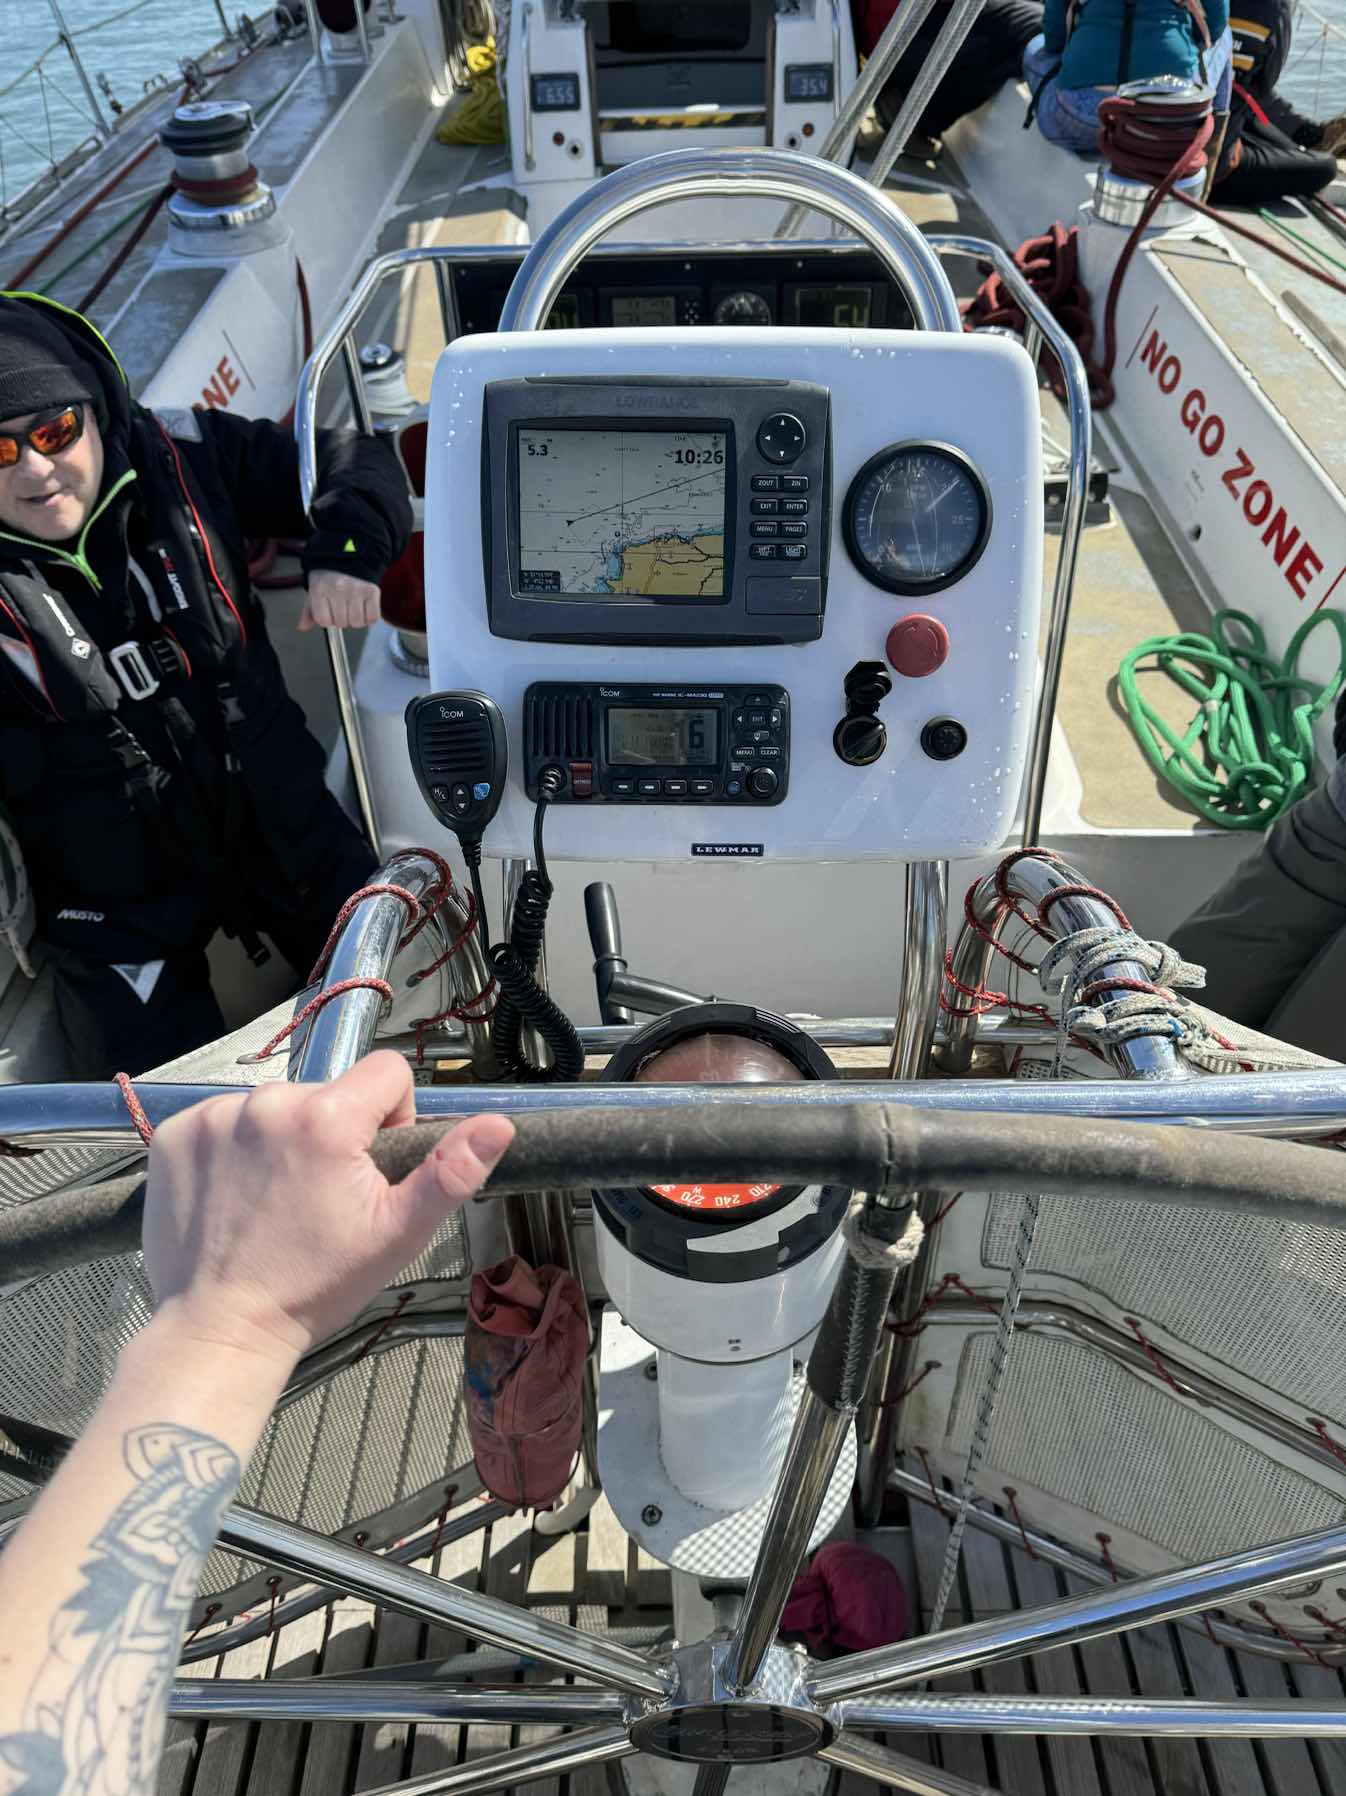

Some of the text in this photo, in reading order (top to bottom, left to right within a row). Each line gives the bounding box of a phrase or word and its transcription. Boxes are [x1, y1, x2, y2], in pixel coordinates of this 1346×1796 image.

[527, 444, 549, 456] 5.3
[674, 449, 724, 464] 10:26
[1140, 329, 1324, 601] NO GO ZONE
[696, 846, 759, 854] LEWMAR
[57, 909, 105, 922] MUSTO
[681, 1191, 705, 1205] 270
[714, 1194, 741, 1207] 240
